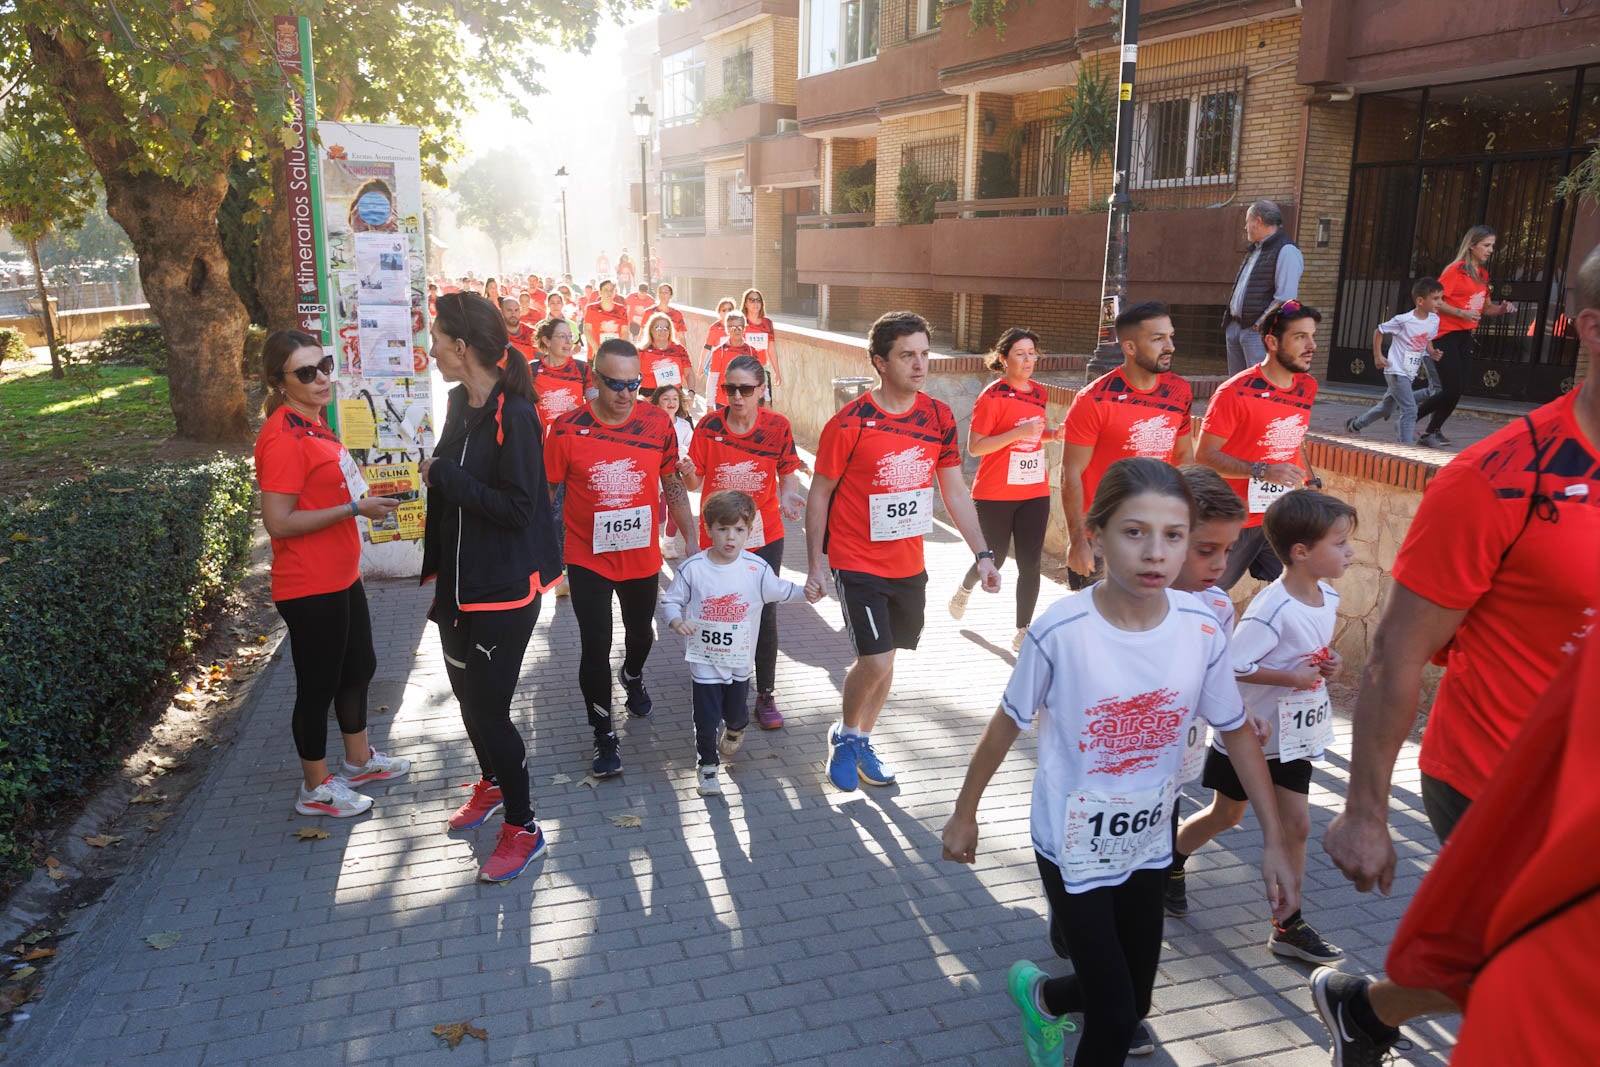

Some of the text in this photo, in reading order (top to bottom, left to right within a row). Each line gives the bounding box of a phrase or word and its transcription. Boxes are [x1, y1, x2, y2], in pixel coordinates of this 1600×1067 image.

[1485, 131, 1496, 150] 2
[880, 463, 930, 477] carrera
[1020, 459, 1038, 469] 903
[887, 500, 918, 518] 582
[603, 516, 642, 534] 1654
[702, 604, 745, 614] carrera
[701, 630, 733, 646] 585
[1088, 712, 1182, 735] carrera
[1087, 802, 1164, 837] 1666
